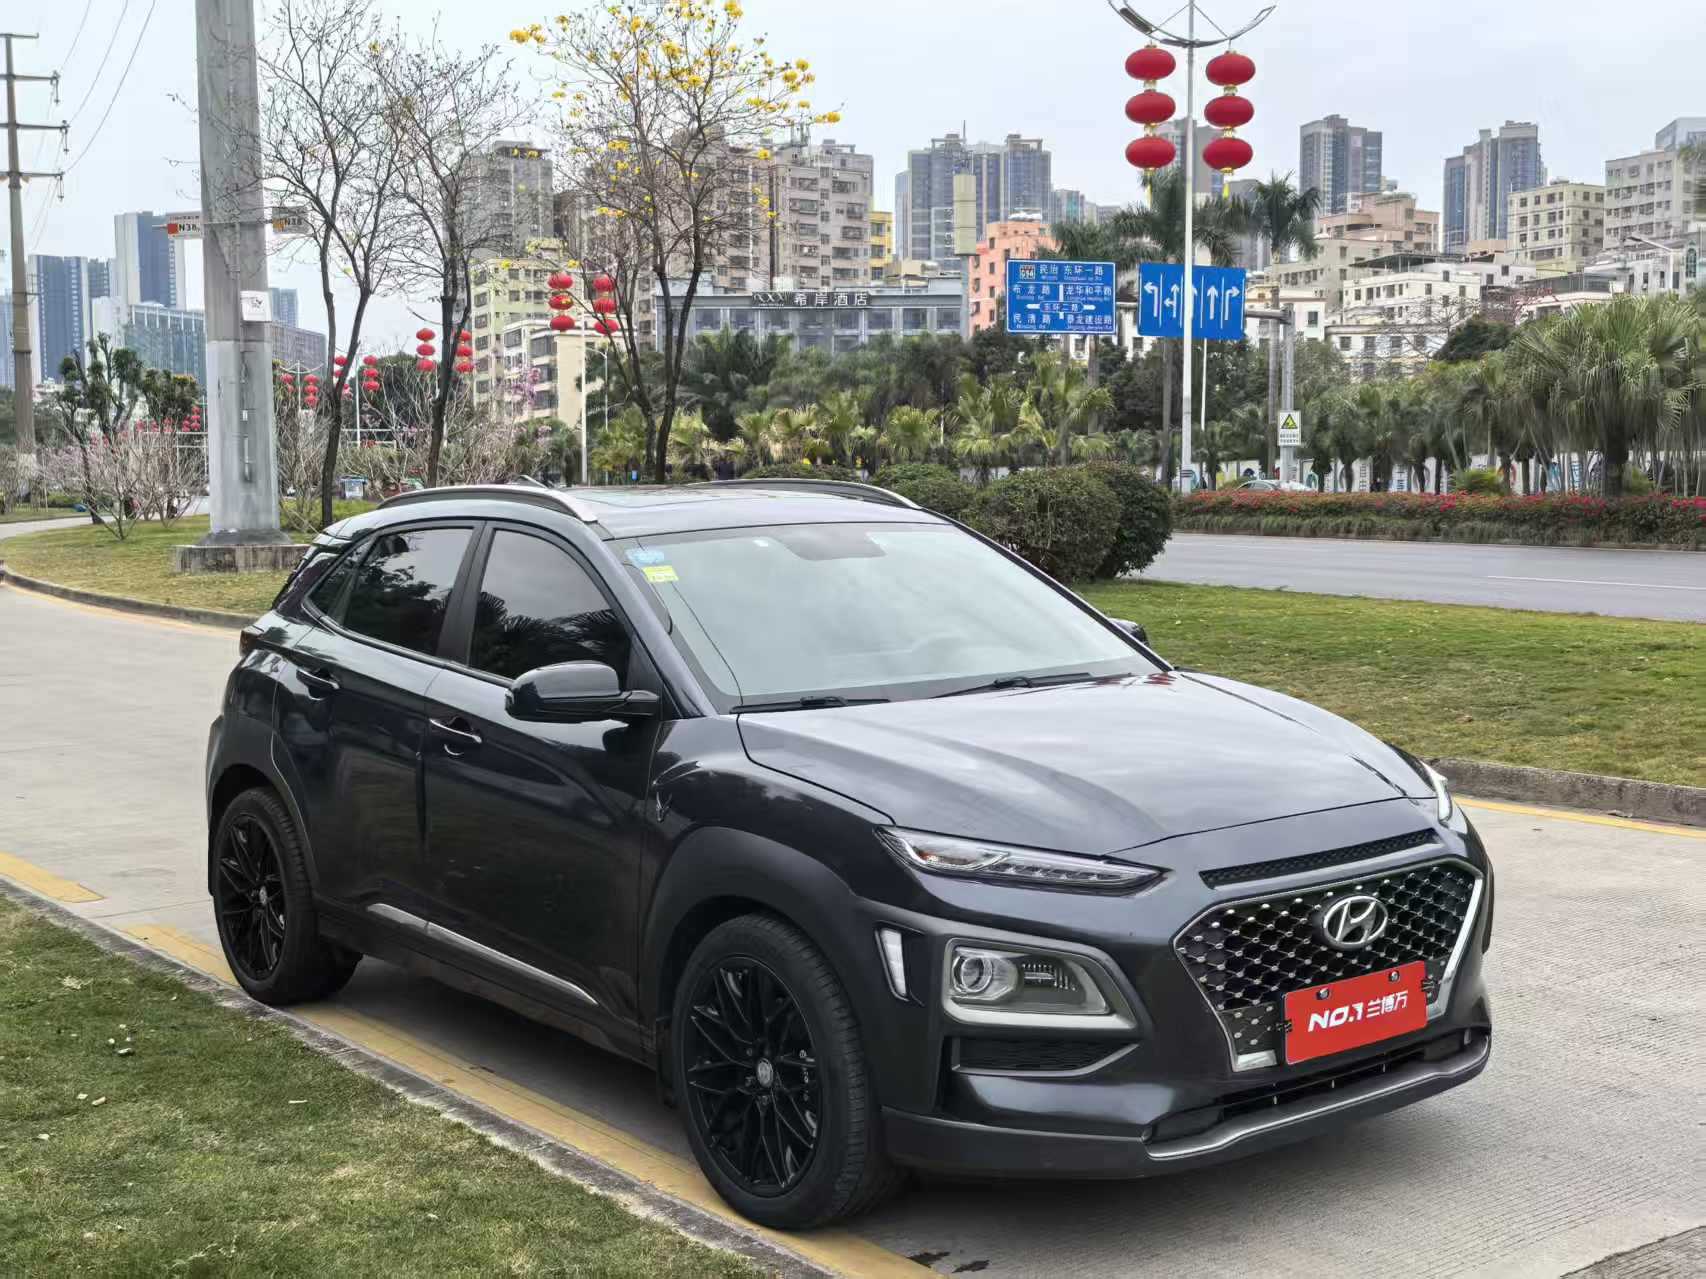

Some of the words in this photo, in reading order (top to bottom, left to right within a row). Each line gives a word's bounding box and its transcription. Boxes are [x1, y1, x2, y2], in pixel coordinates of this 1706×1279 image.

[1040, 264, 1058, 274] 民治
[1063, 265, 1103, 276] 东环一路
[1013, 285, 1050, 295] 布龙路
[1065, 285, 1112, 296] 龙华和平路
[795, 291, 867, 307] 希岸酒店
[1043, 303, 1078, 312] 东环二路
[1307, 1002, 1364, 1033] NO.1
[1366, 990, 1409, 1018] 兰博万
